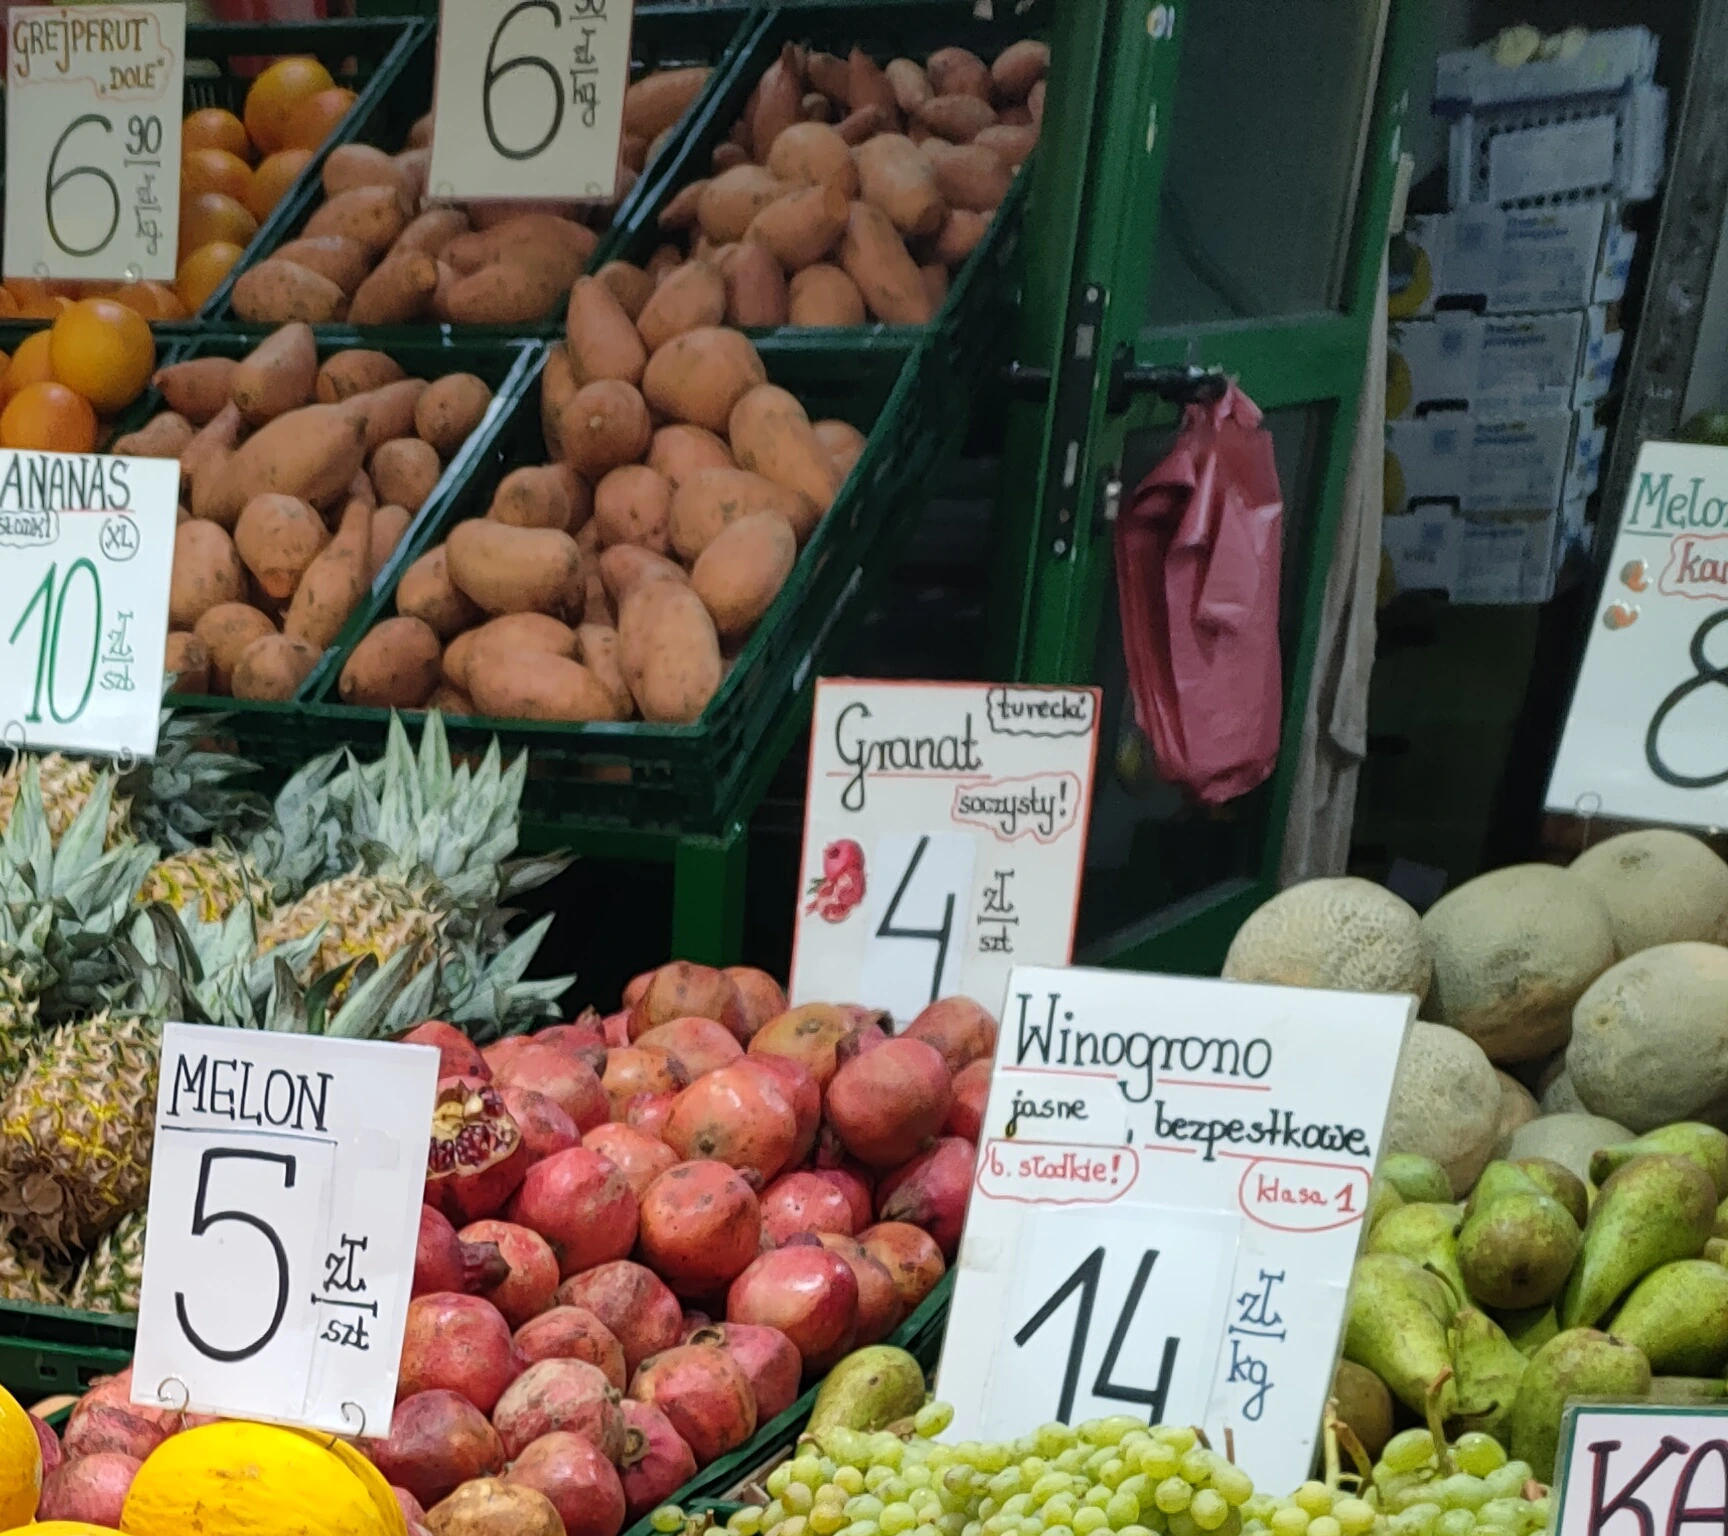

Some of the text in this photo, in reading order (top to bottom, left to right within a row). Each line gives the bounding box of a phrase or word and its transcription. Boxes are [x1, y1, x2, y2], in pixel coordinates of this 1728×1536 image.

[483, 1, 565, 160] 6
[45, 113, 163, 257] 6 90
[104, 523, 135, 550] XL
[1628, 471, 1728, 530] Melo
[8, 556, 103, 724] 10
[998, 688, 1087, 720] turecki
[835, 702, 983, 812] Granat
[958, 781, 1068, 836] soczysty!
[875, 835, 956, 1003] 4
[979, 925, 1014, 952] szt
[1015, 992, 1273, 1103] Winogrono
[166, 1053, 334, 1132] MELON
[1154, 1099, 1371, 1162] bezpestkowe
[1019, 1153, 1122, 1185] słodkie!
[1256, 1174, 1356, 1212] klasa 1
[175, 1147, 296, 1363] 5
[320, 1315, 369, 1350] szt
[1013, 1246, 1181, 1427] 14
[1227, 1339, 1273, 1421] kg
